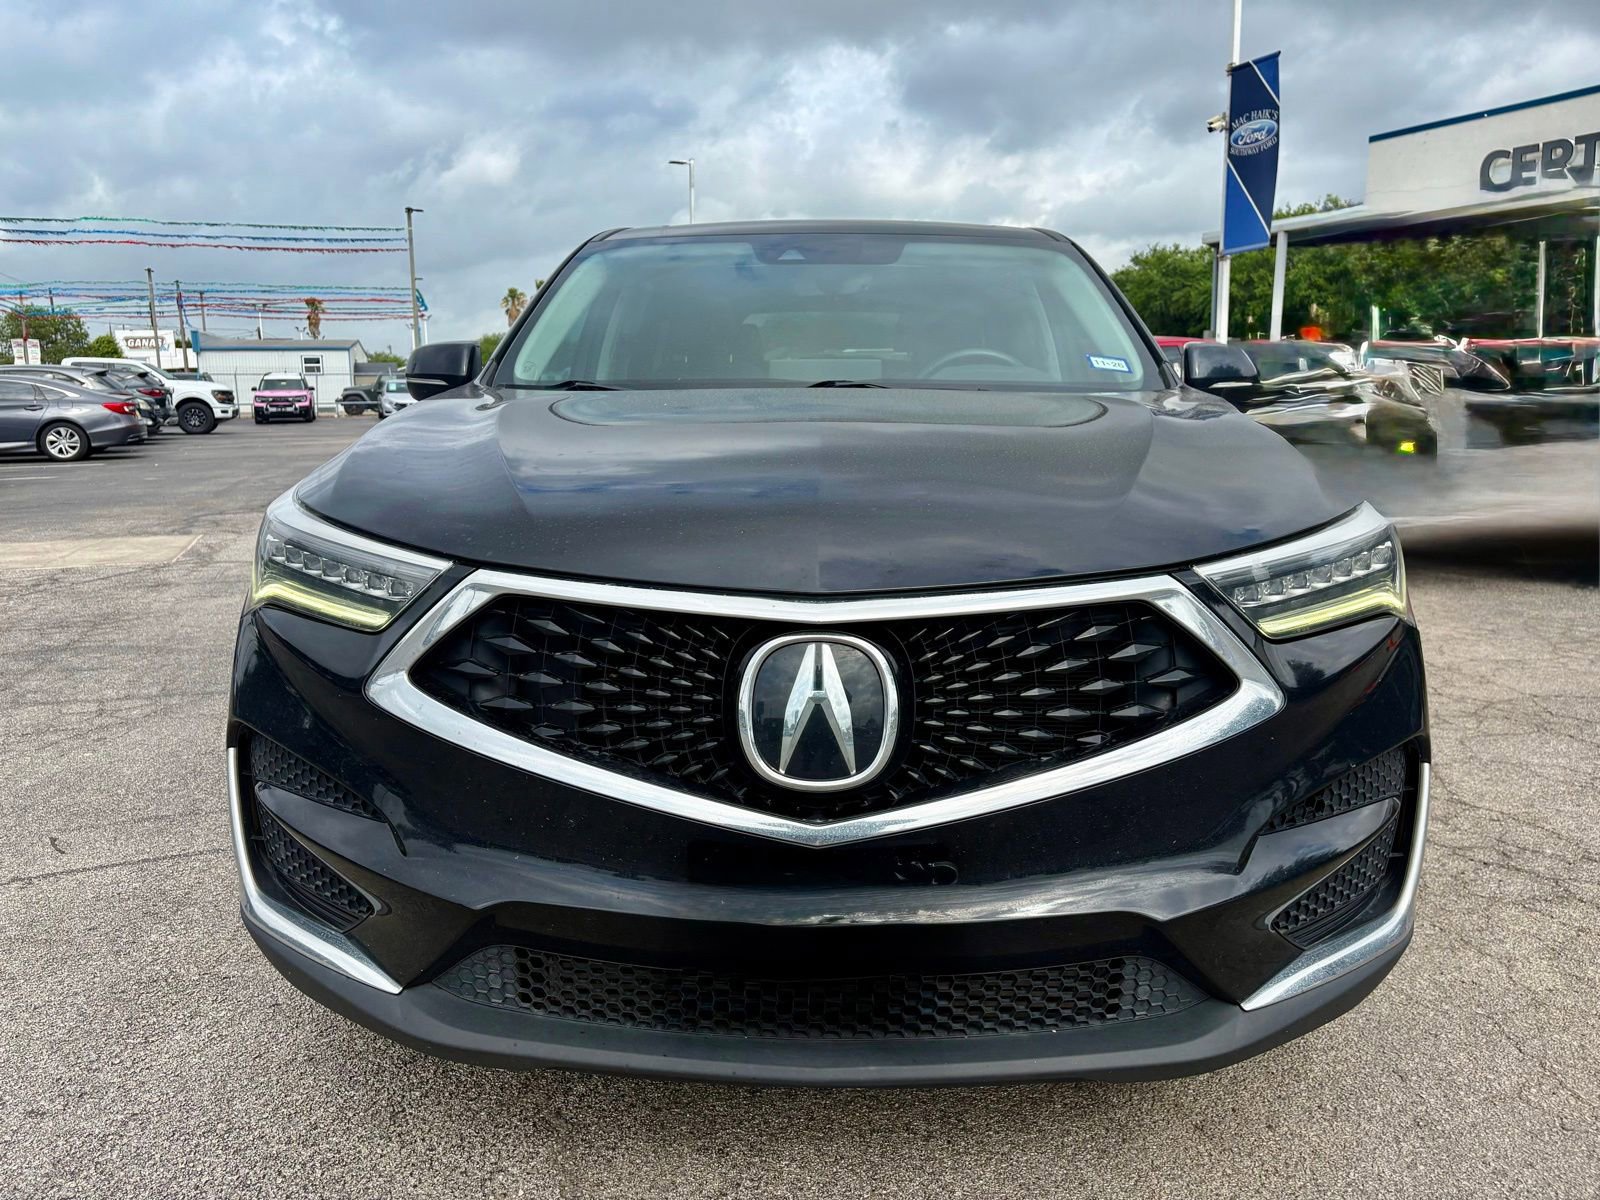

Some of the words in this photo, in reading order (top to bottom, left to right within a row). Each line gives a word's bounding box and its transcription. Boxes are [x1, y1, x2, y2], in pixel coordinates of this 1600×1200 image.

[1231, 113, 1249, 130] MAC
[1251, 109, 1278, 120] HAIK'S
[1238, 125, 1269, 145] Ford
[1230, 145, 1259, 156] SOUTHWAY
[1260, 136, 1278, 151] FORD
